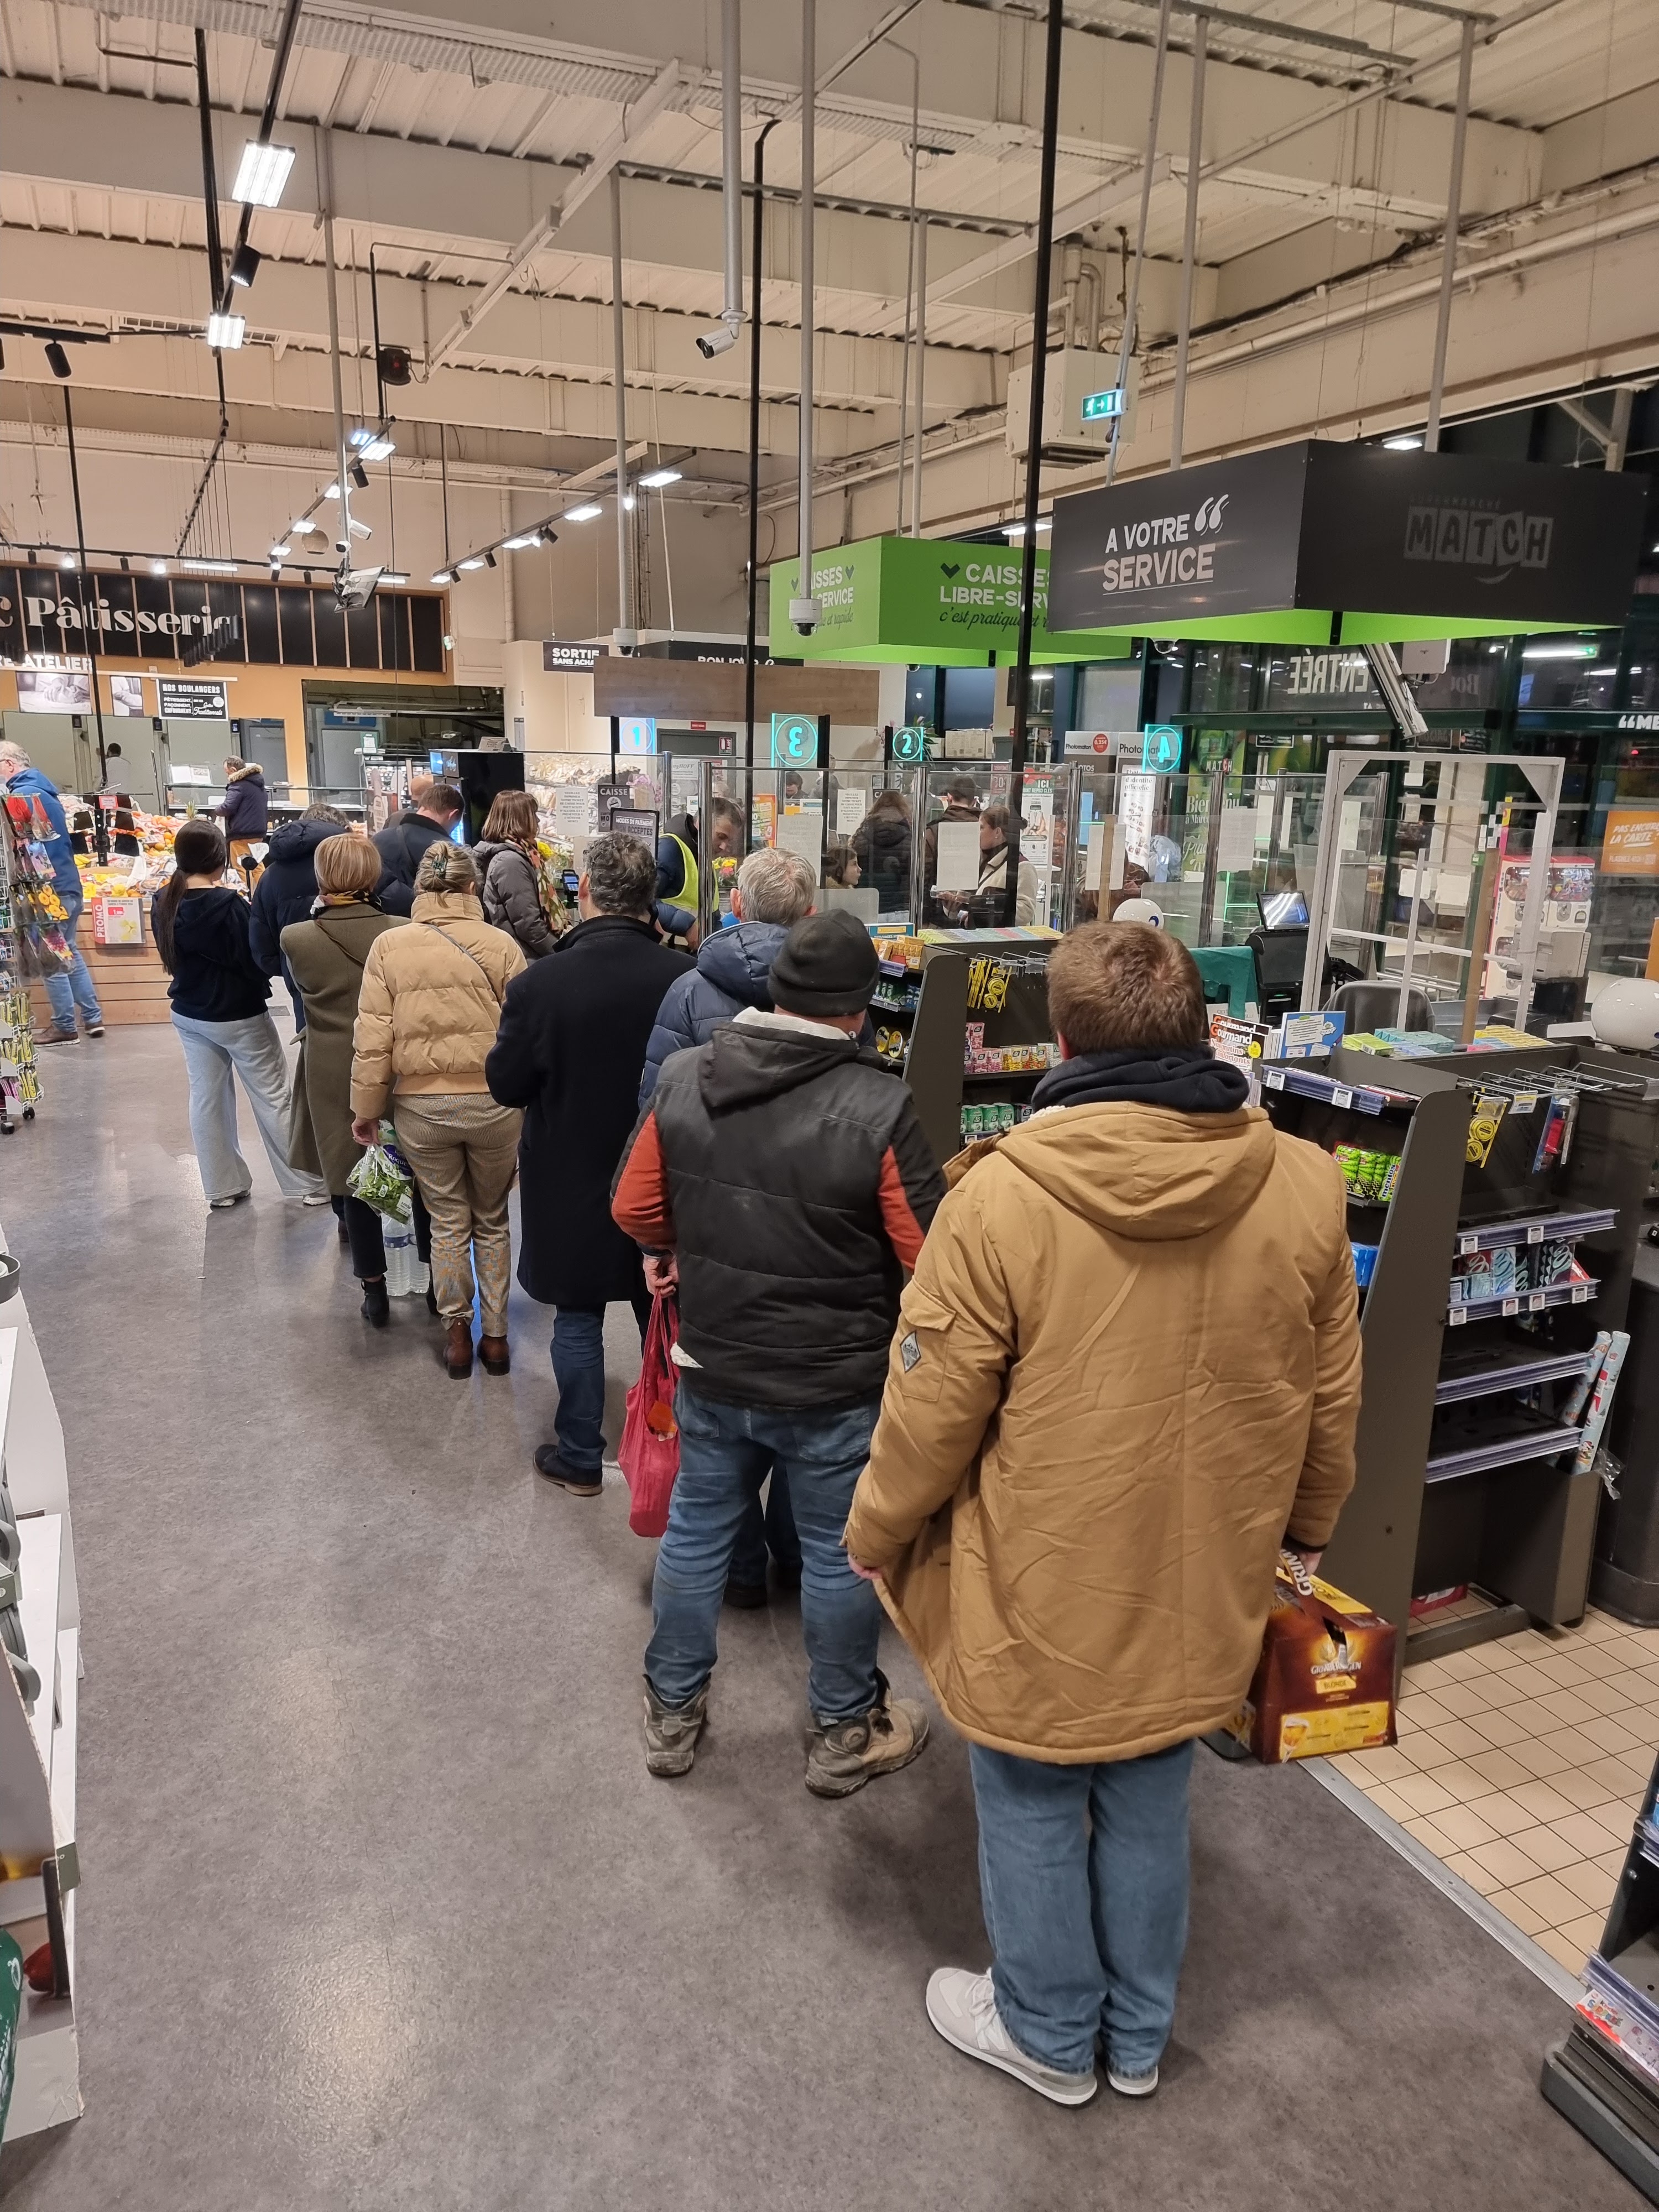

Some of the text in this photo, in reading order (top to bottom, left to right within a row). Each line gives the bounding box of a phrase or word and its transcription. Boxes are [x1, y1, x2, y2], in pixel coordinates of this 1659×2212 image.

[1105, 514, 1191, 554] A VOTRE
[1406, 510, 1551, 564] MATCH
[966, 564, 1050, 588] CAISE
[1102, 543, 1217, 591] SERVICE
[811, 566, 843, 591] ISSES
[940, 607, 969, 623] c'est
[967, 611, 1021, 632] pratiqu
[162, 684, 221, 693] NOS BOULANGERS
[632, 726, 640, 747] 1
[901, 734, 912, 754] 2
[1206, 758, 1233, 773] MATCH
[599, 788, 628, 796] CAISSE
[1037, 780, 1050, 788] ICI
[1609, 834, 1622, 844] LA
[1624, 832, 1653, 843] CARTE
[95, 904, 105, 937] PROMO
[1210, 1024, 1253, 1045] Gourmand
[1381, 1164, 1396, 1197] mentos
